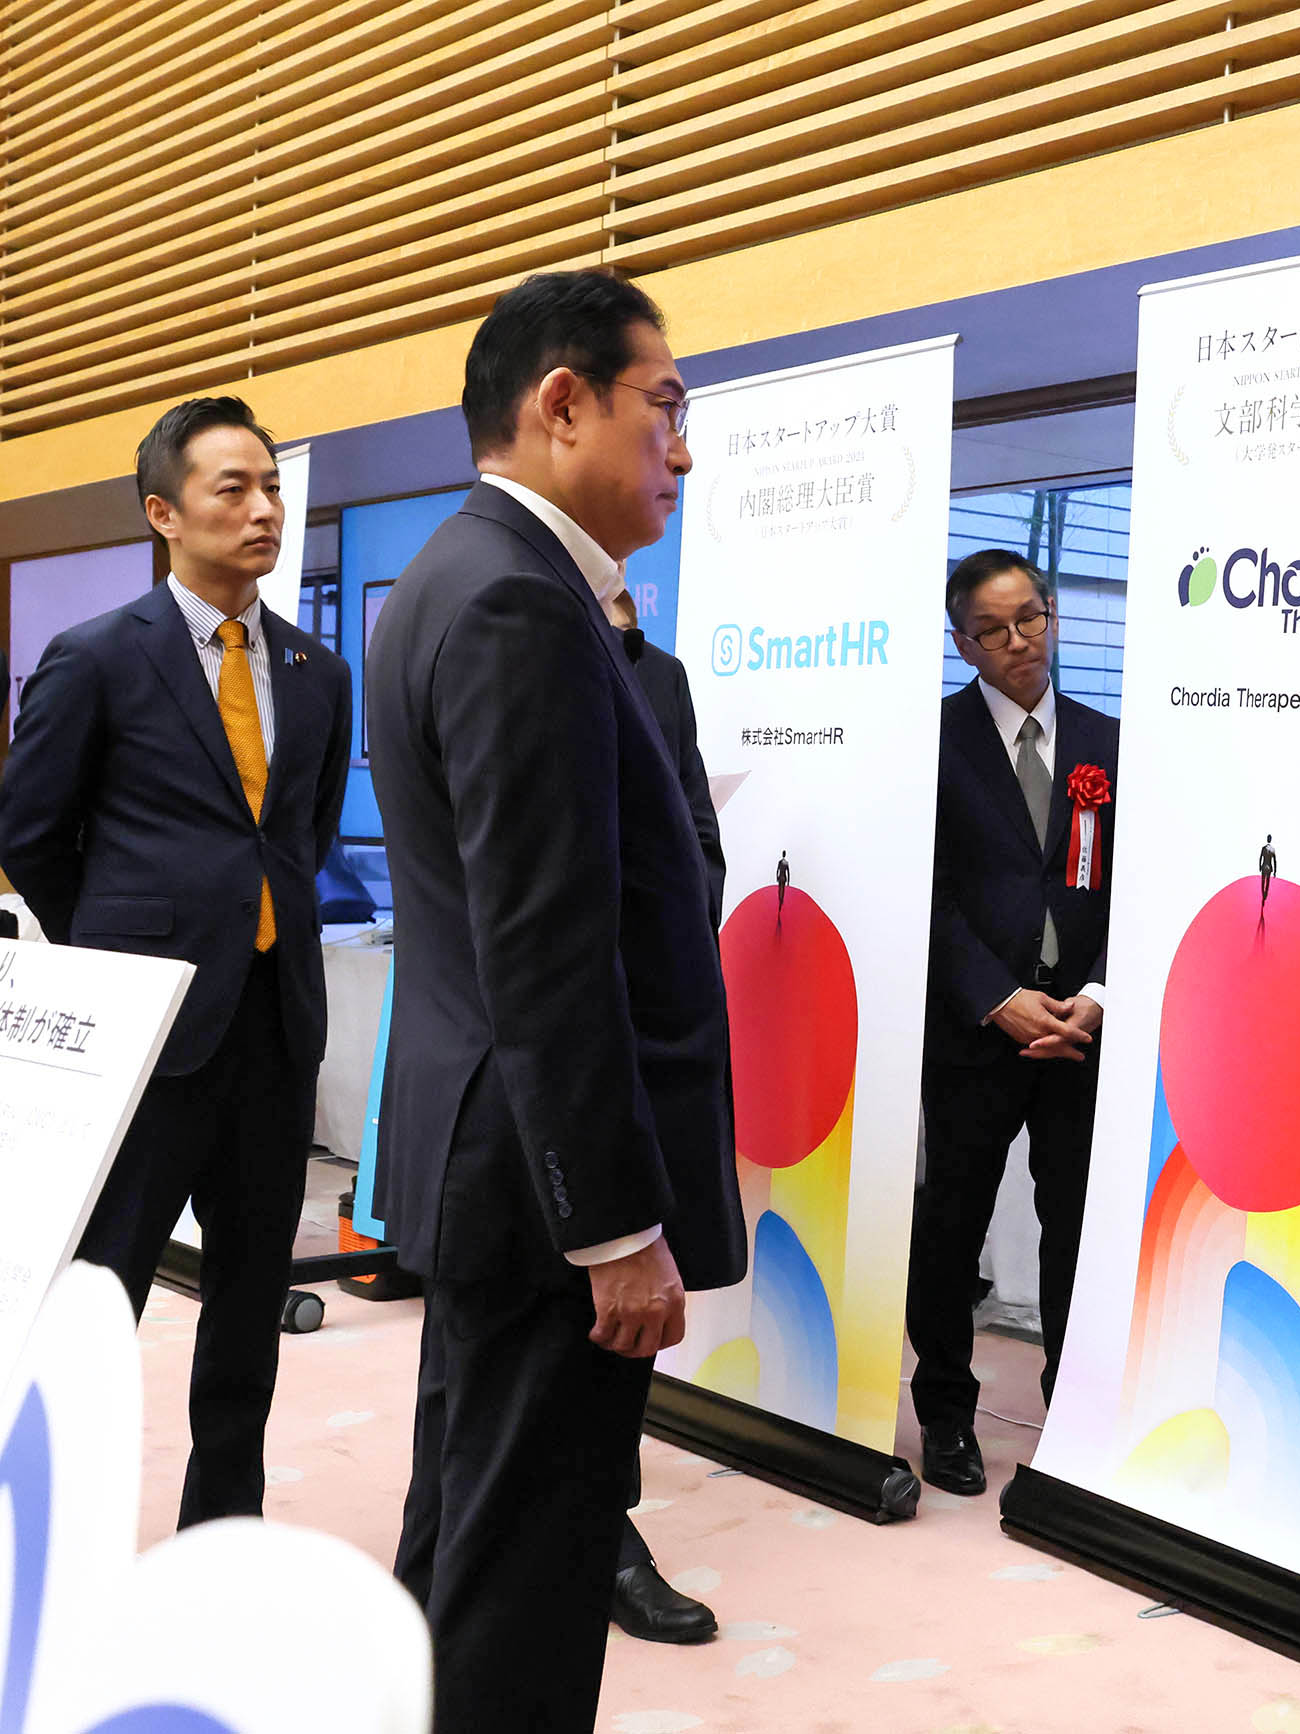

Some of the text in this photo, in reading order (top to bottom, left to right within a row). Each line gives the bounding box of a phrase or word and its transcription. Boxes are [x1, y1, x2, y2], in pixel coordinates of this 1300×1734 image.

[1233, 372, 1270, 387] NIPPON
[729, 403, 898, 457] 日本スタートアップ大賞
[740, 472, 875, 519] 内閣総理大臣賞
[747, 620, 889, 671] SmartHR
[1170, 686, 1231, 707] Chordia
[742, 727, 844, 746] 株式会社SmartHR
[0, 1001, 96, 1053] 体制が確立
